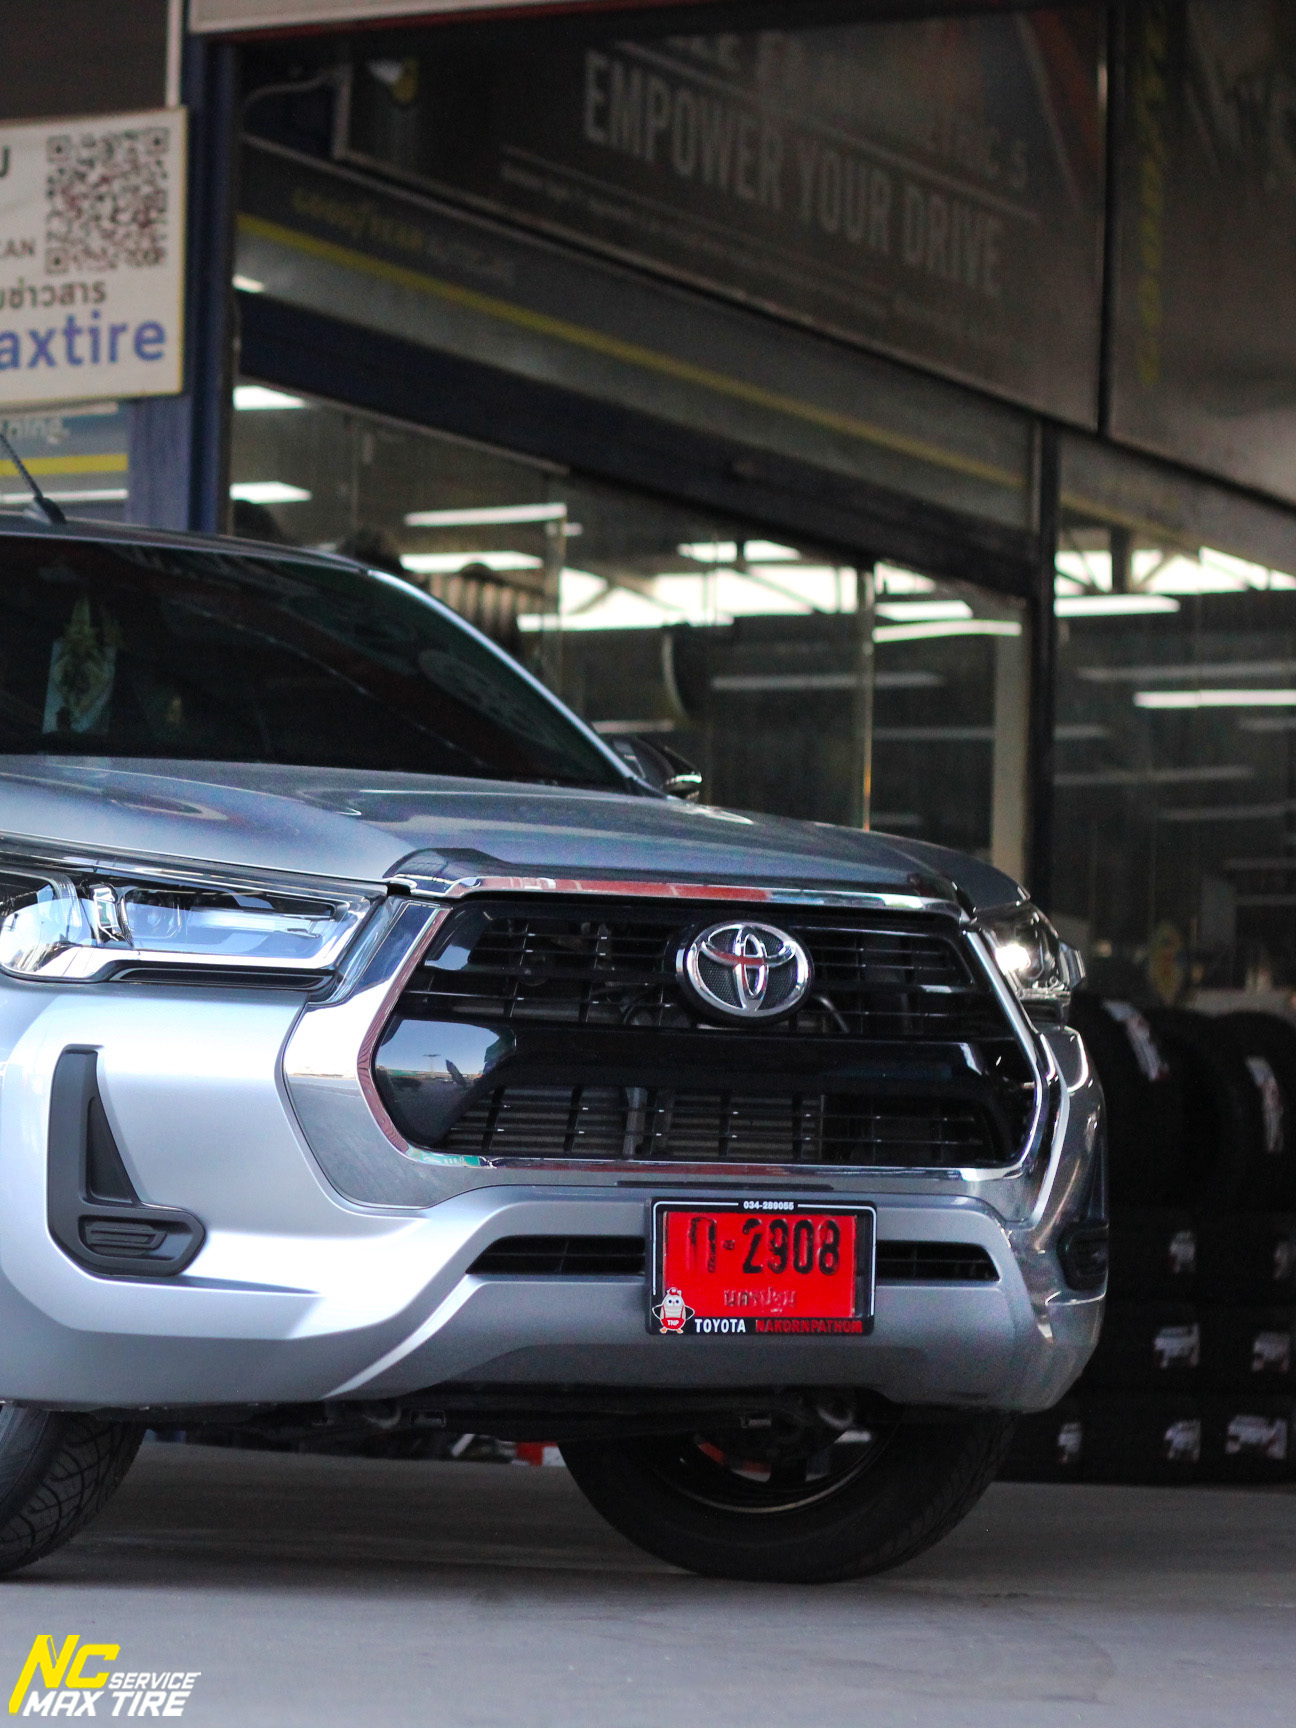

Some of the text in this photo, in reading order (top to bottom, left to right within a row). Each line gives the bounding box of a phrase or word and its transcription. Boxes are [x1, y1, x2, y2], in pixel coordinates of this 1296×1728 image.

[584, 48, 784, 211] EMPOWER
[799, 138, 893, 257] YOUR
[904, 184, 1003, 298] DRIVE
[694, 1318, 863, 1334] TOYOTA NAKORNPATHOM
